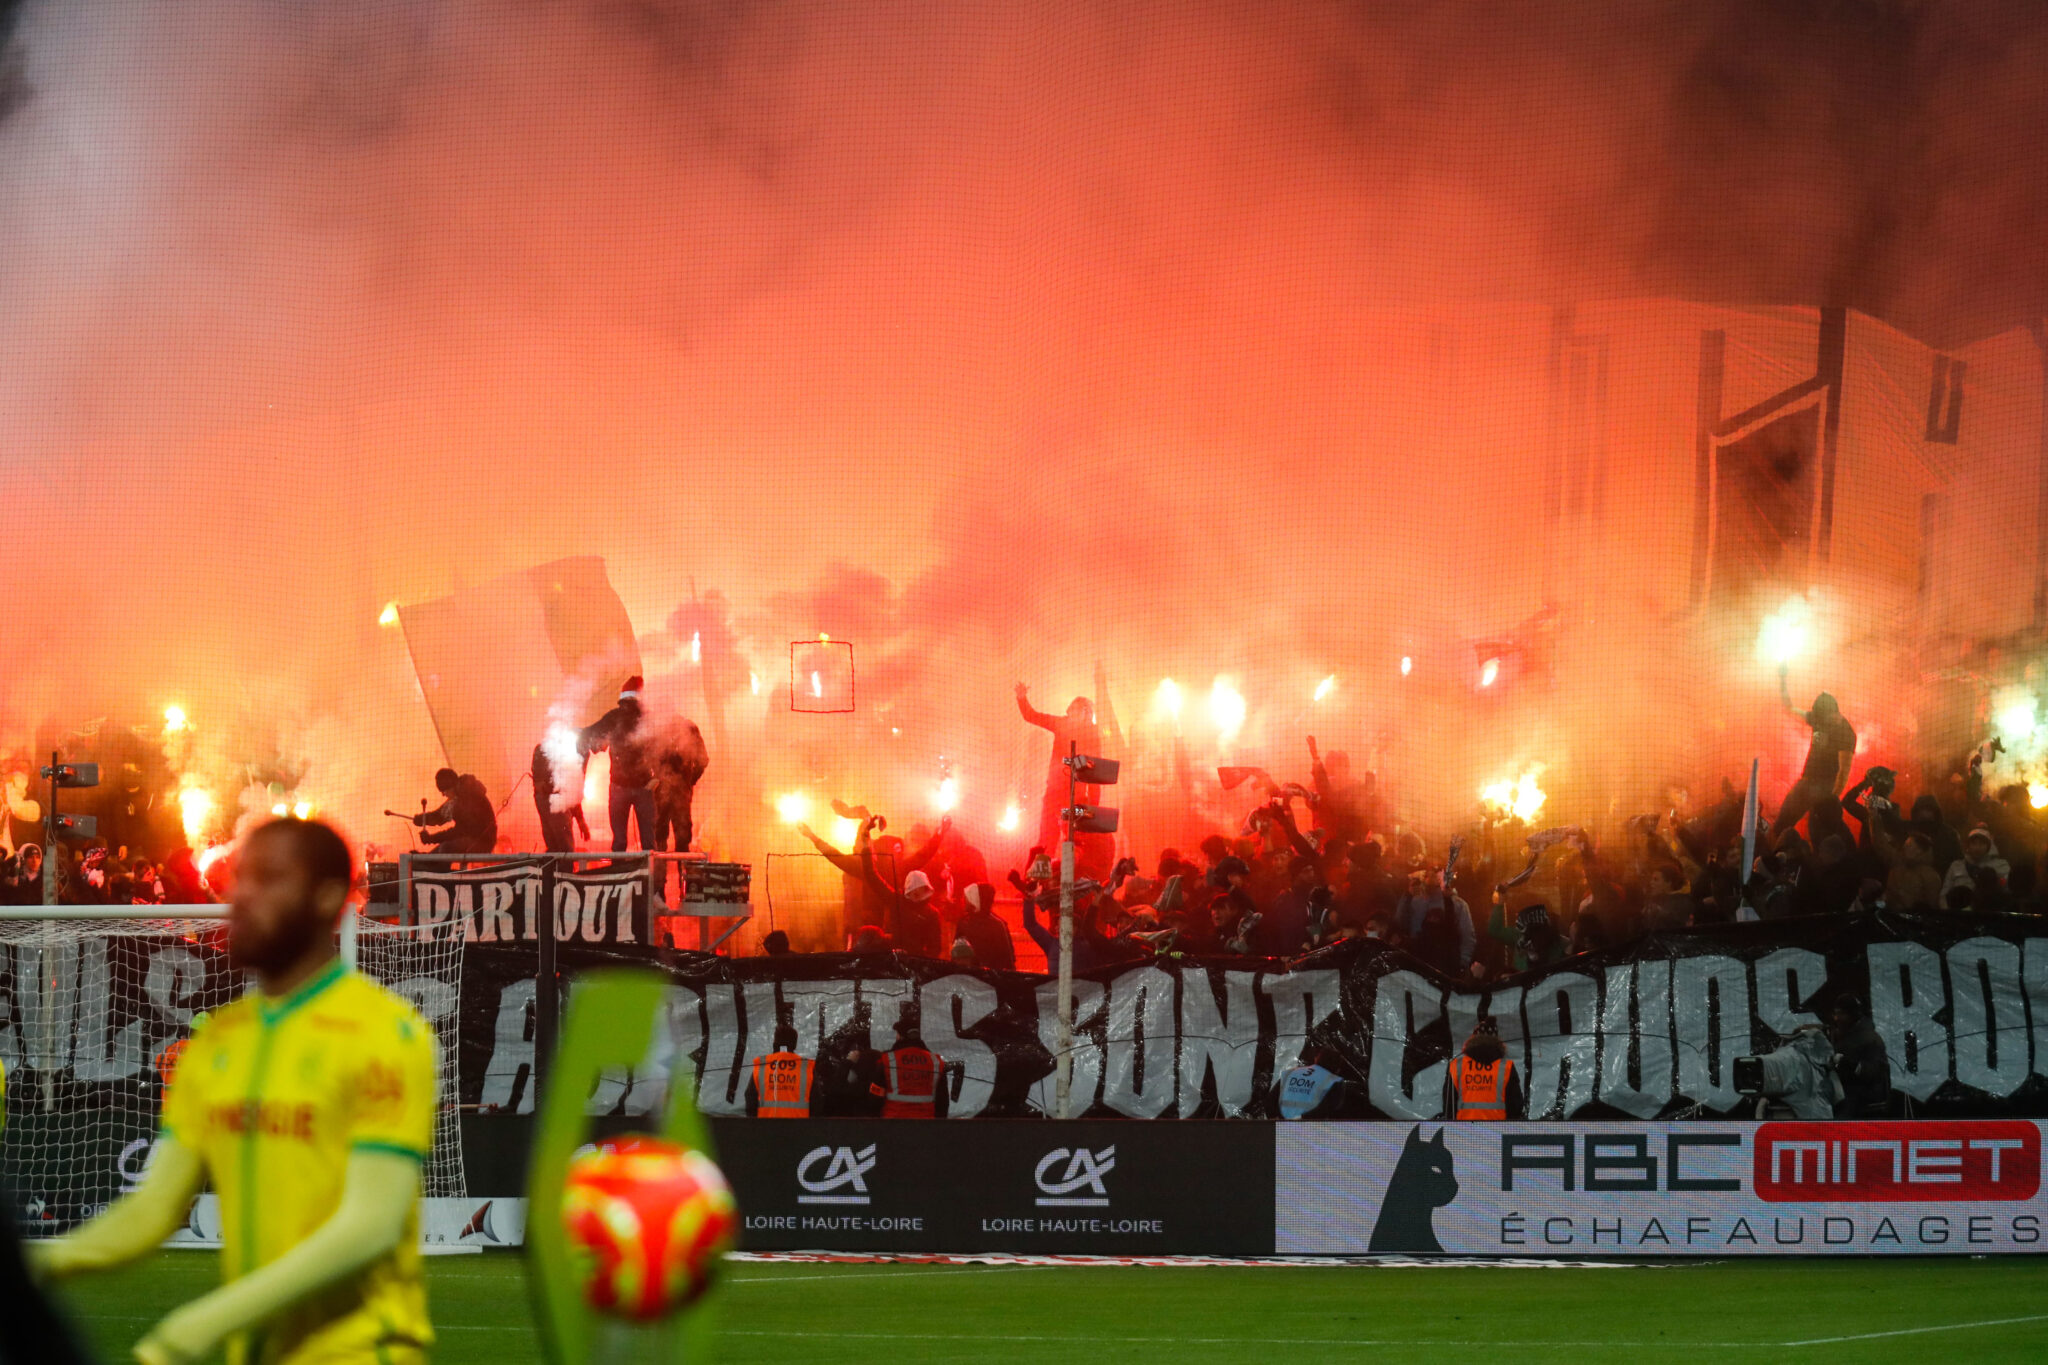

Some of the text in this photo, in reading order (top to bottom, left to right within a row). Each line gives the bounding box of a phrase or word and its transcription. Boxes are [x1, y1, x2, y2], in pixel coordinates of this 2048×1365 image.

[415, 879, 643, 943] PARTOUT
[1027, 966, 1341, 1118] SONT
[1867, 937, 2048, 1102] BO
[769, 1060, 796, 1071] 609
[768, 1073, 796, 1084] DOM
[1289, 1077, 1316, 1088] DOM
[1465, 1074, 1493, 1084] DOM
[1501, 1134, 2023, 1191] ABC MINET
[745, 1216, 923, 1231] LOIRE HAUTE-LOIRE
[982, 1219, 1163, 1233] LOIRE HAUTE-LOIRE
[1501, 1212, 2041, 1245] ÉCHAFAUDAGES
